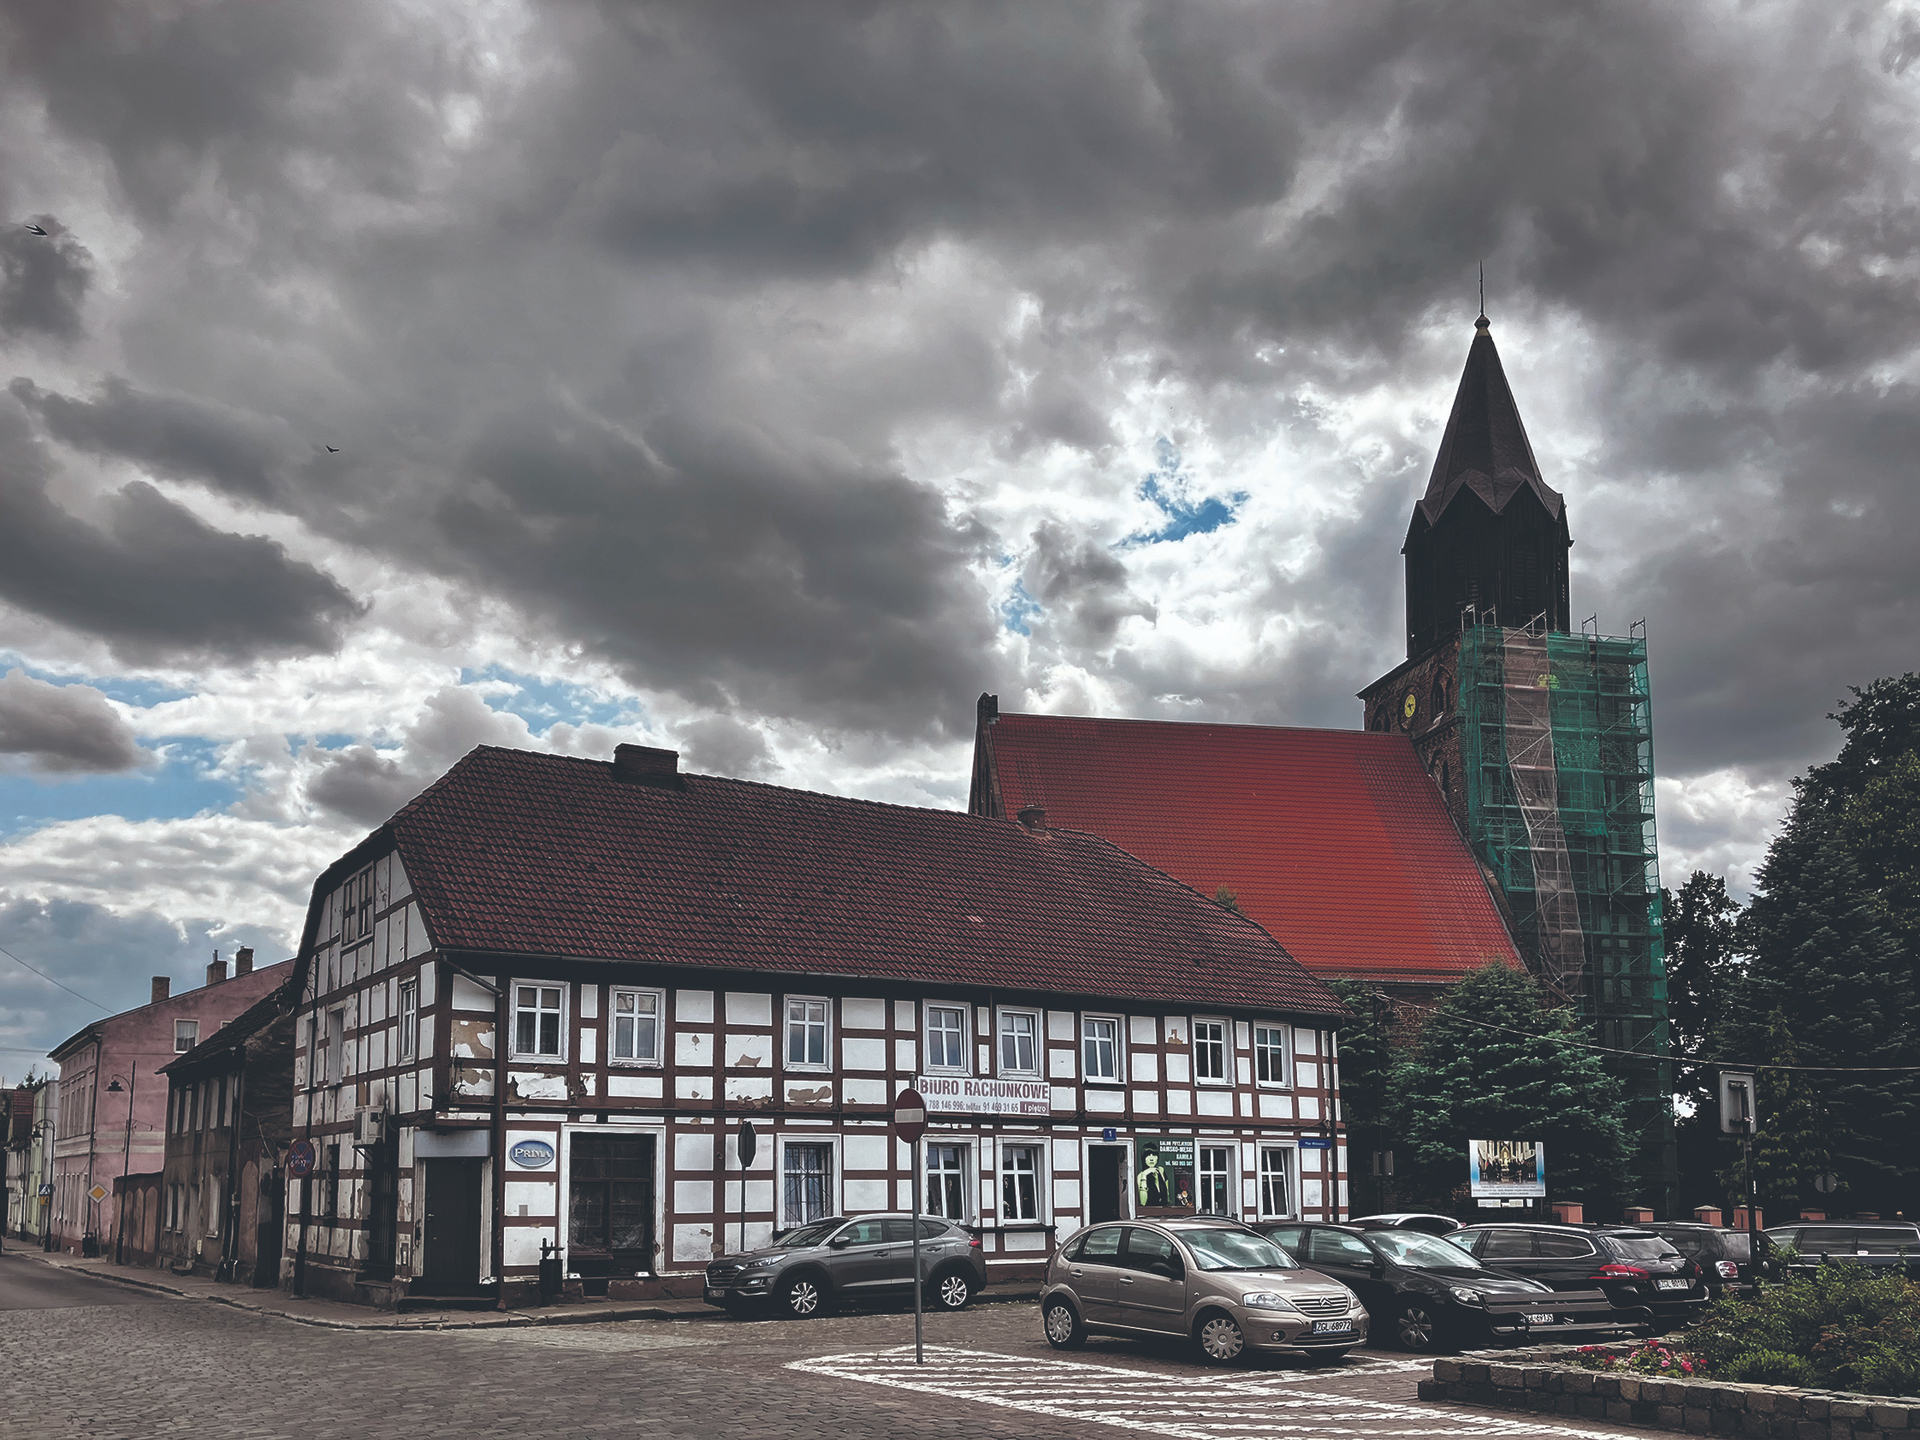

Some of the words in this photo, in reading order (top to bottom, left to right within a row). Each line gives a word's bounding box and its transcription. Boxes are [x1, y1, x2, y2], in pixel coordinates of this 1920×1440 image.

[964, 1080, 1049, 1099] RACHUNKOWE
[929, 1100, 940, 1110] 788
[941, 1100, 952, 1110] 146
[982, 1102, 990, 1111] 91
[991, 1102, 1002, 1112] 469
[1003, 1103, 1010, 1112] 31
[1011, 1103, 1019, 1113] 65
[1316, 1322, 1328, 1331] ZGL
[1331, 1320, 1351, 1331] 68972
